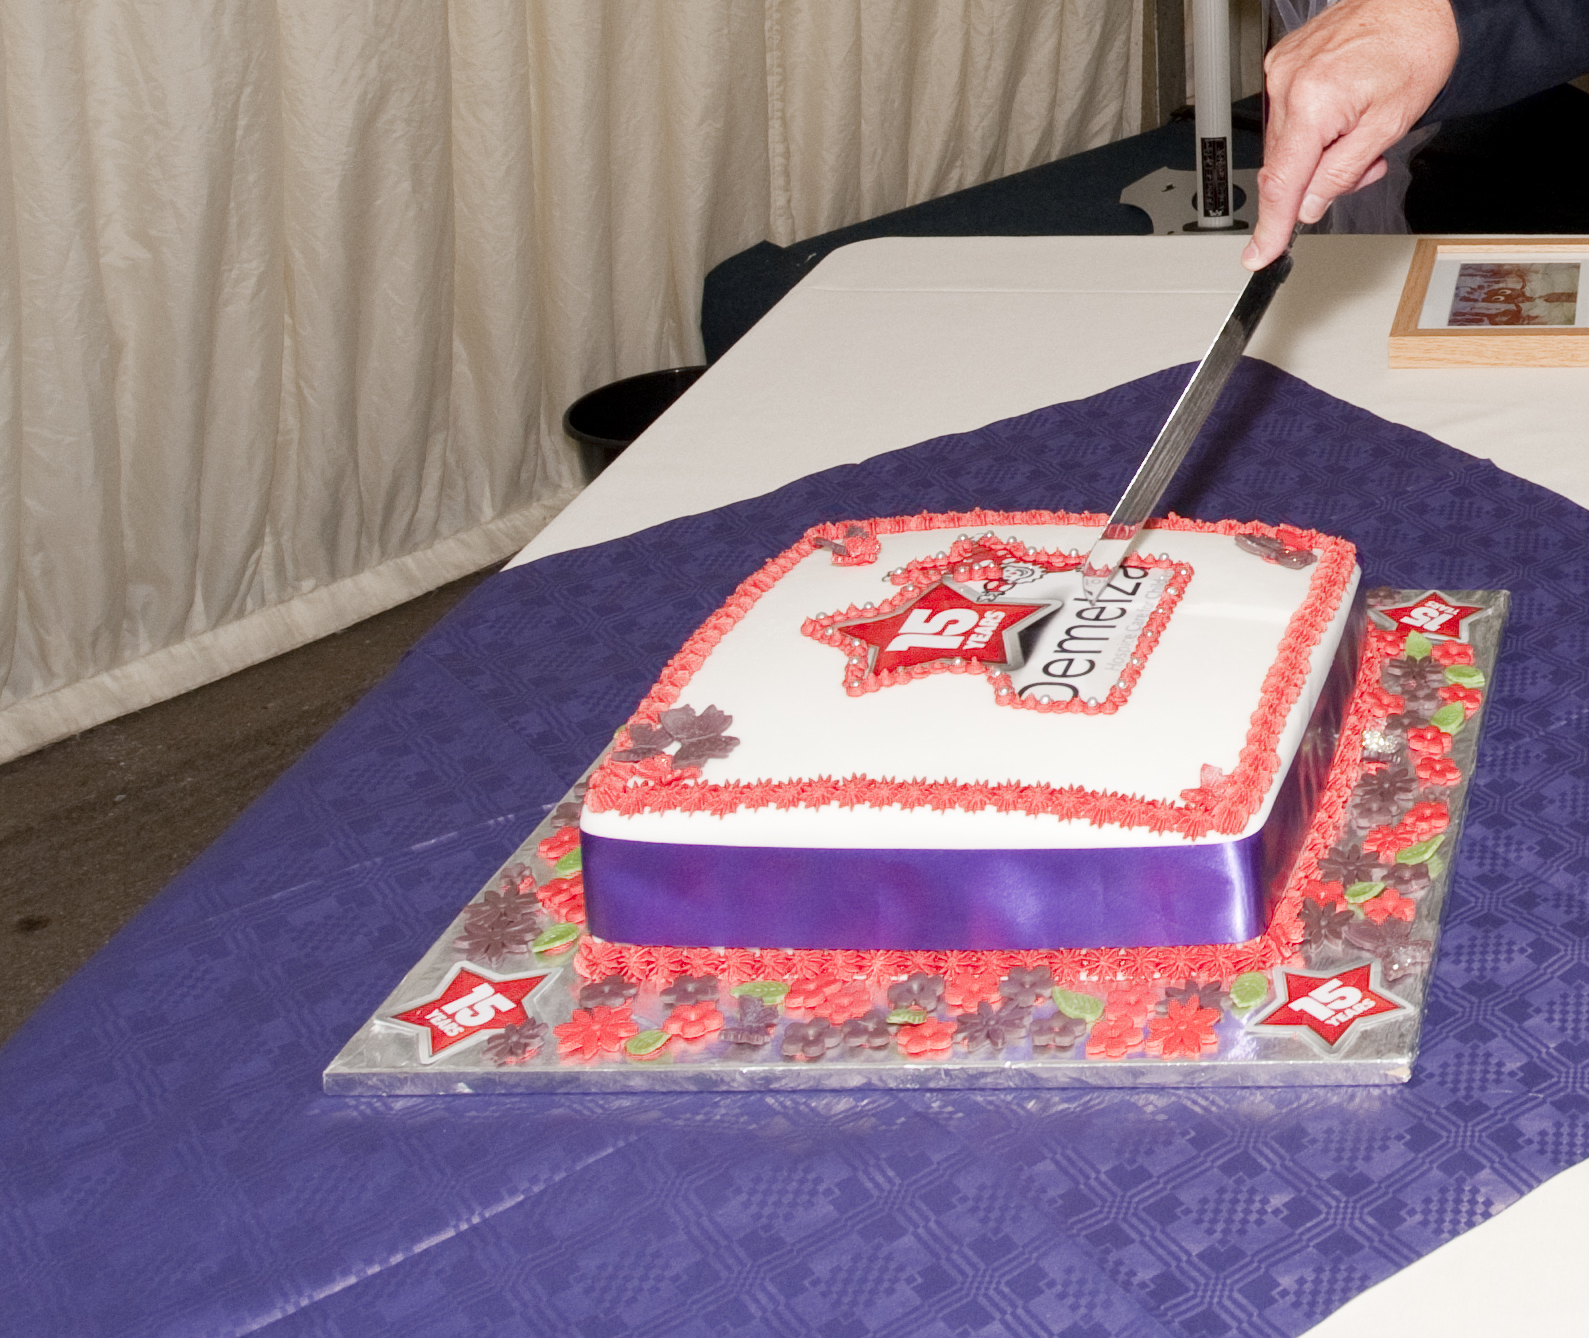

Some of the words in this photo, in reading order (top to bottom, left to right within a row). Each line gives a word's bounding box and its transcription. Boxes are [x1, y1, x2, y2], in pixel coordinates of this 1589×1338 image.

[1400, 606, 1454, 632] 15
[1424, 600, 1460, 616] YEARS
[886, 605, 980, 653] 15
[963, 610, 1006, 651] YEARS
[1105, 632, 1138, 671] Hospice
[1126, 612, 1147, 632] Care
[440, 982, 517, 1027] 15
[1287, 978, 1363, 1022] 15
[1324, 997, 1377, 1027] YEARS
[424, 1008, 465, 1037] YEARS
